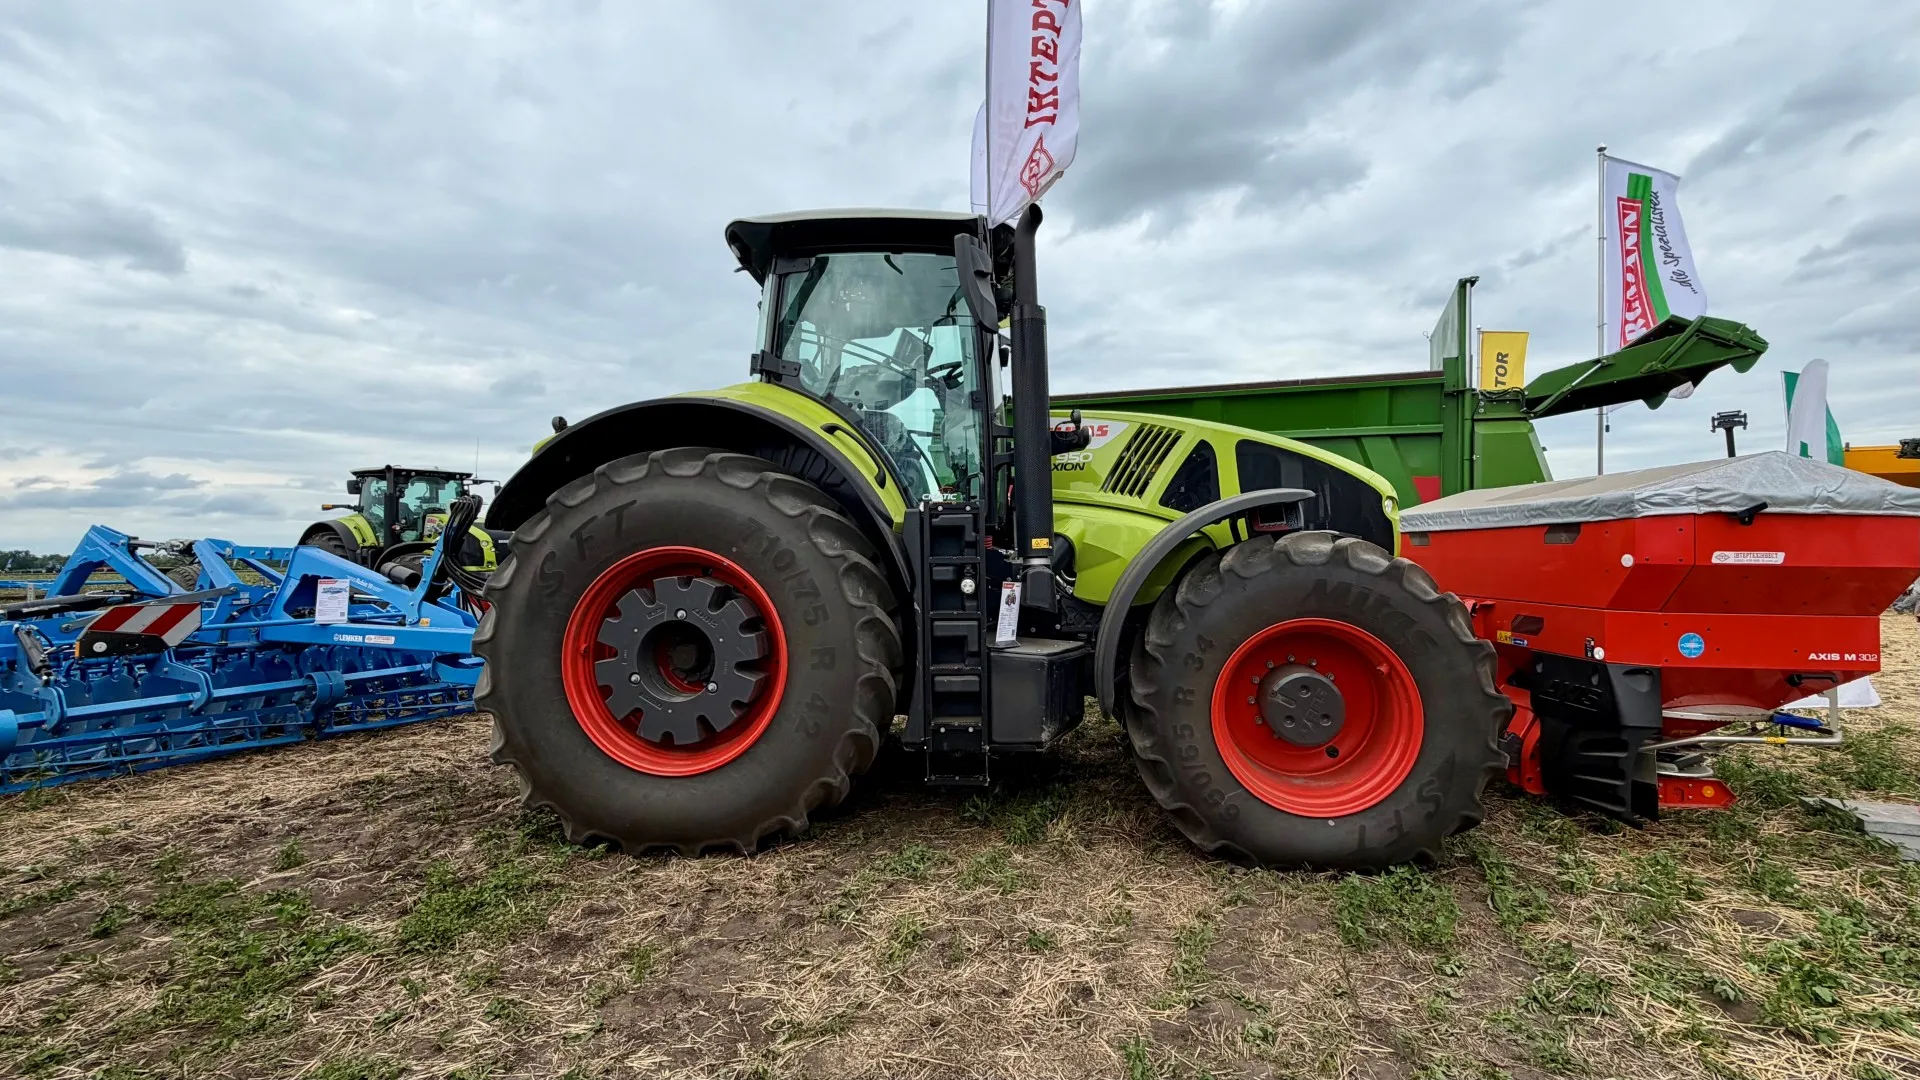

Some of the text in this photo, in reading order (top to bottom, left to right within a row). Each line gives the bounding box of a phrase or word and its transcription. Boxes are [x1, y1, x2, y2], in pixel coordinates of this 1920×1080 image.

[1623, 210, 1647, 342] RGMANN
[1056, 452, 1093, 463] 950
[1051, 462, 1086, 472] XION
[339, 634, 363, 643] LEMKEN
[810, 646, 837, 672] R
[1808, 653, 1840, 661] AXIS
[1844, 653, 1856, 661] M
[1173, 685, 1196, 706] R
[794, 692, 830, 738] 42
